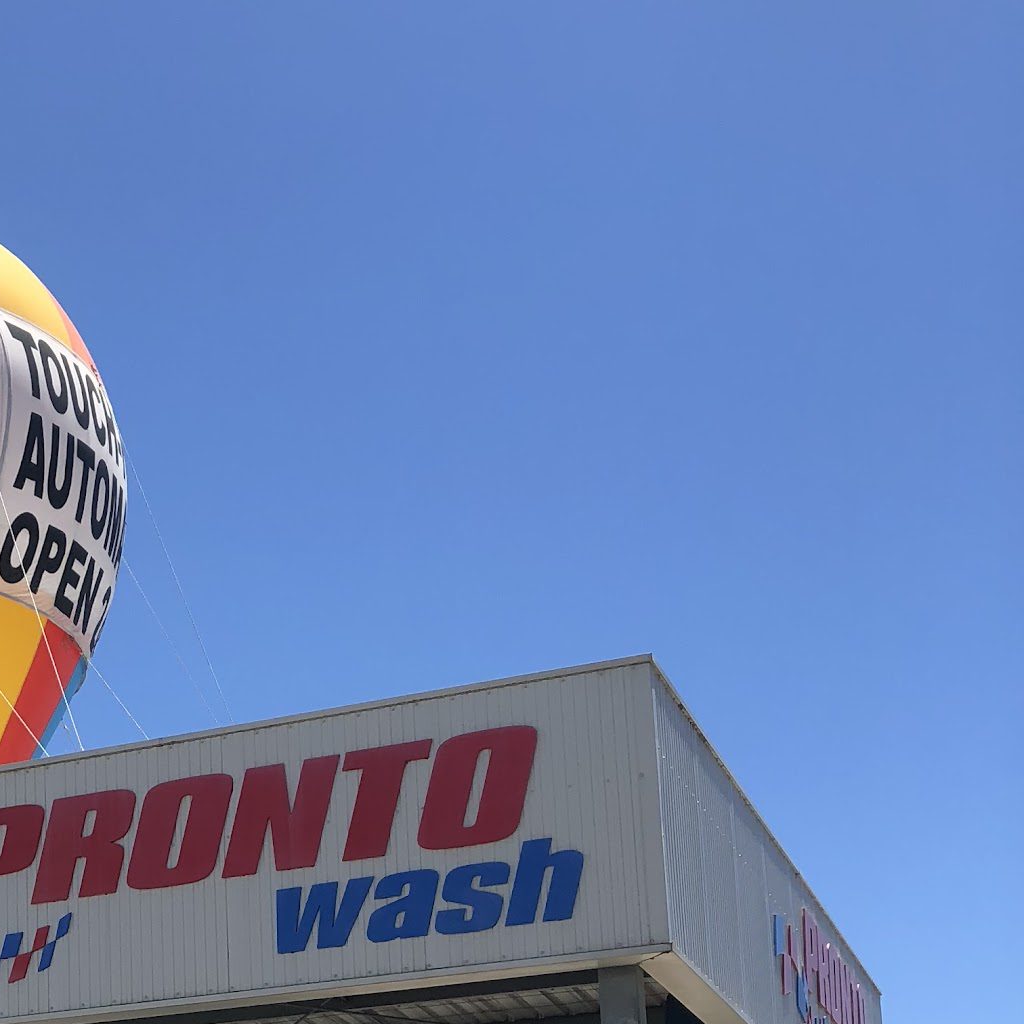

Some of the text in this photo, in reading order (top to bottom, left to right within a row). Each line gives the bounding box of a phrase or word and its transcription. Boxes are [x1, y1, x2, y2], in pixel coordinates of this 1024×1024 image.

[5, 321, 125, 478] TOUCH-
[13, 412, 126, 570] AUTOM
[89, 586, 112, 657] 2
[275, 837, 585, 956] wash
